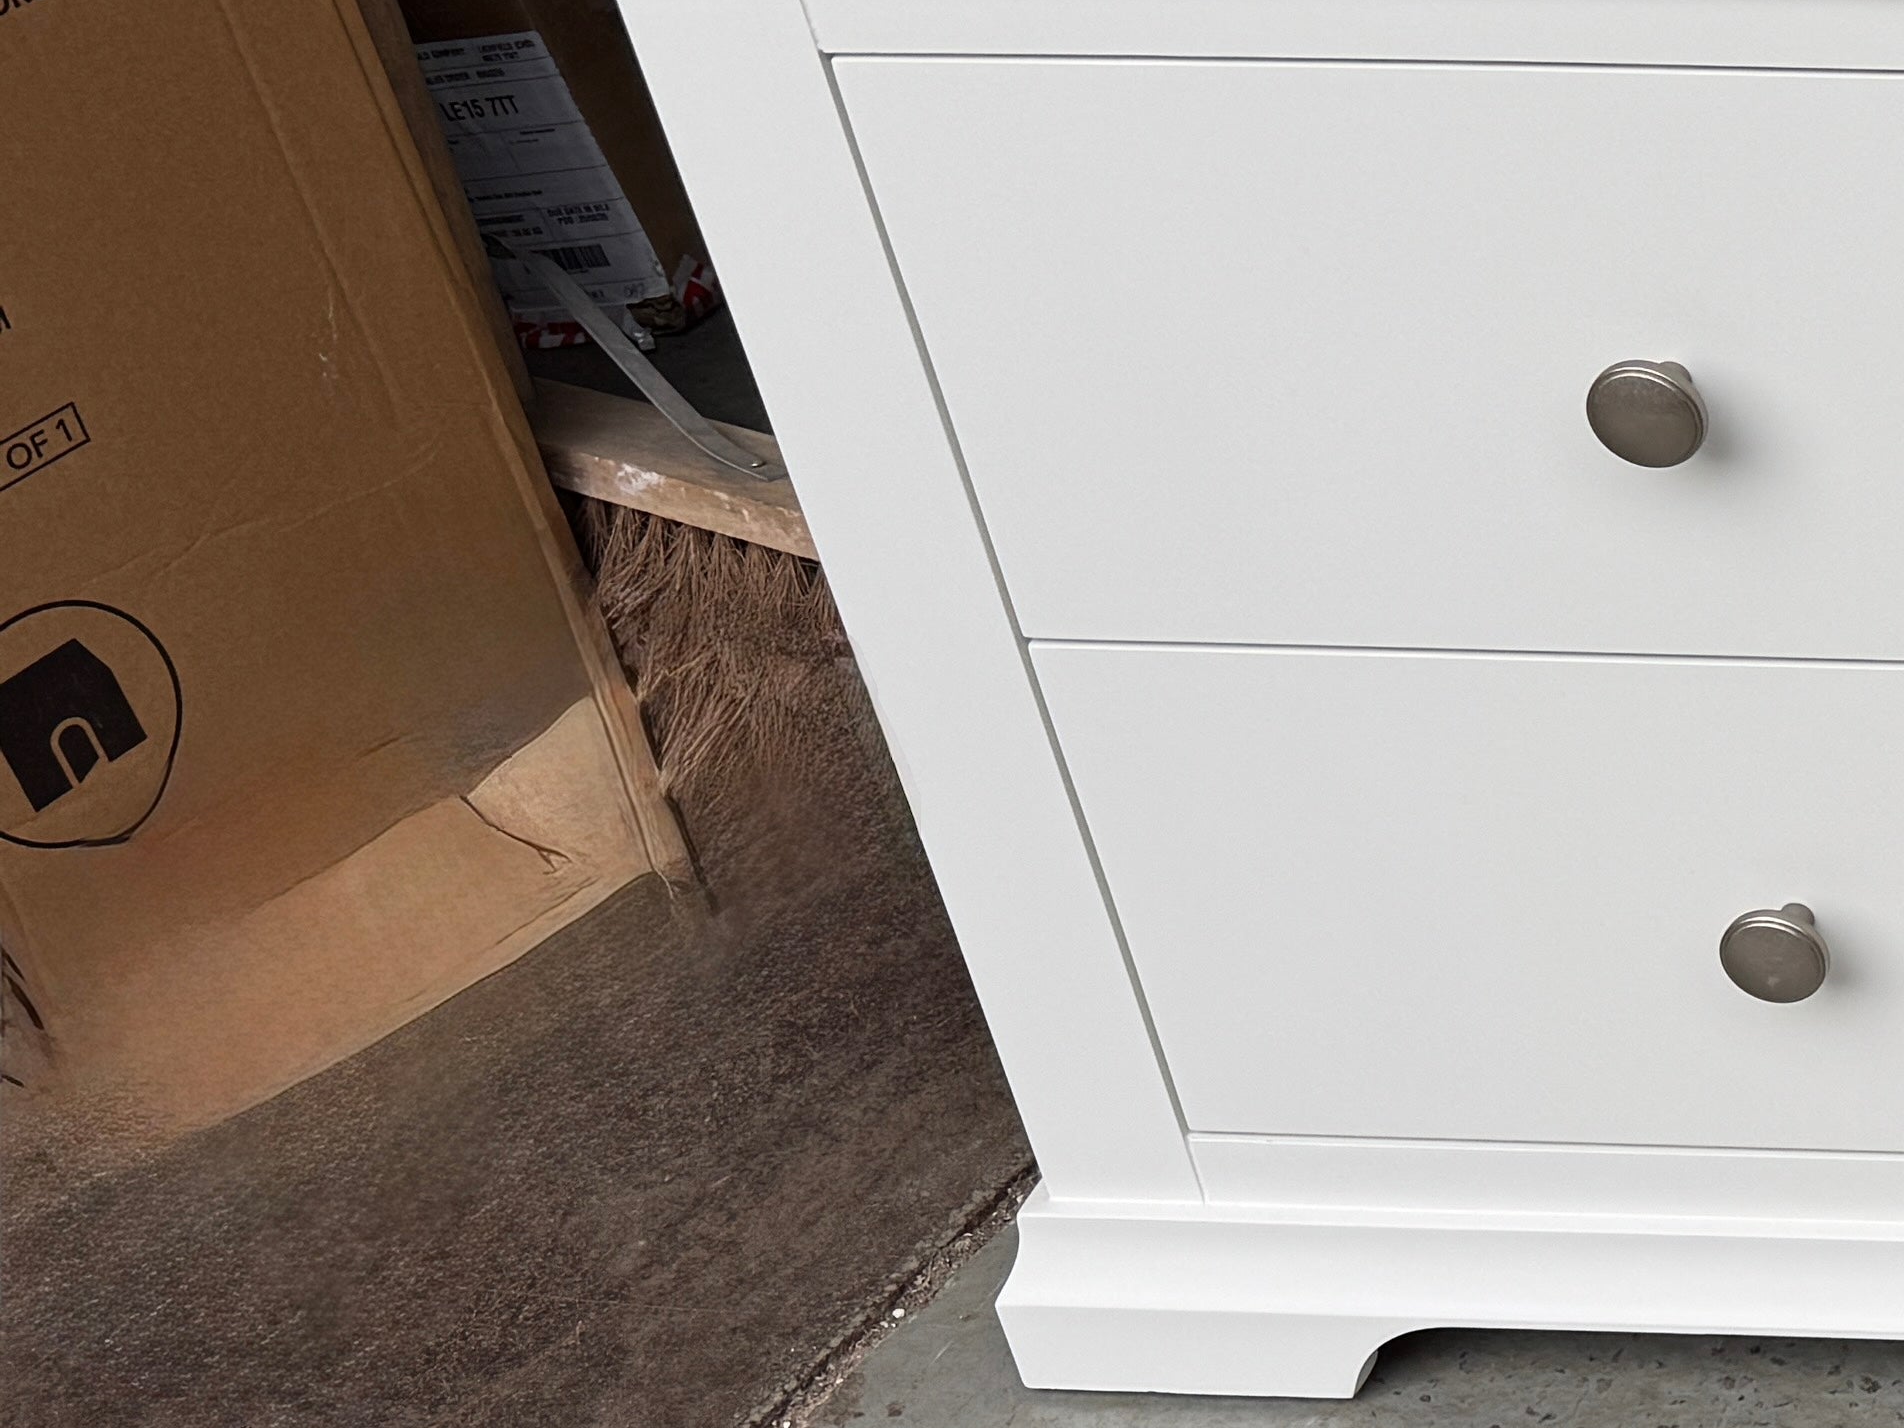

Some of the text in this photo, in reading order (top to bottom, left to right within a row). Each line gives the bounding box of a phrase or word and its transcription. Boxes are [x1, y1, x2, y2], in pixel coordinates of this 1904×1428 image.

[440, 96, 484, 122] LE15
[6, 418, 73, 470] OF 1
